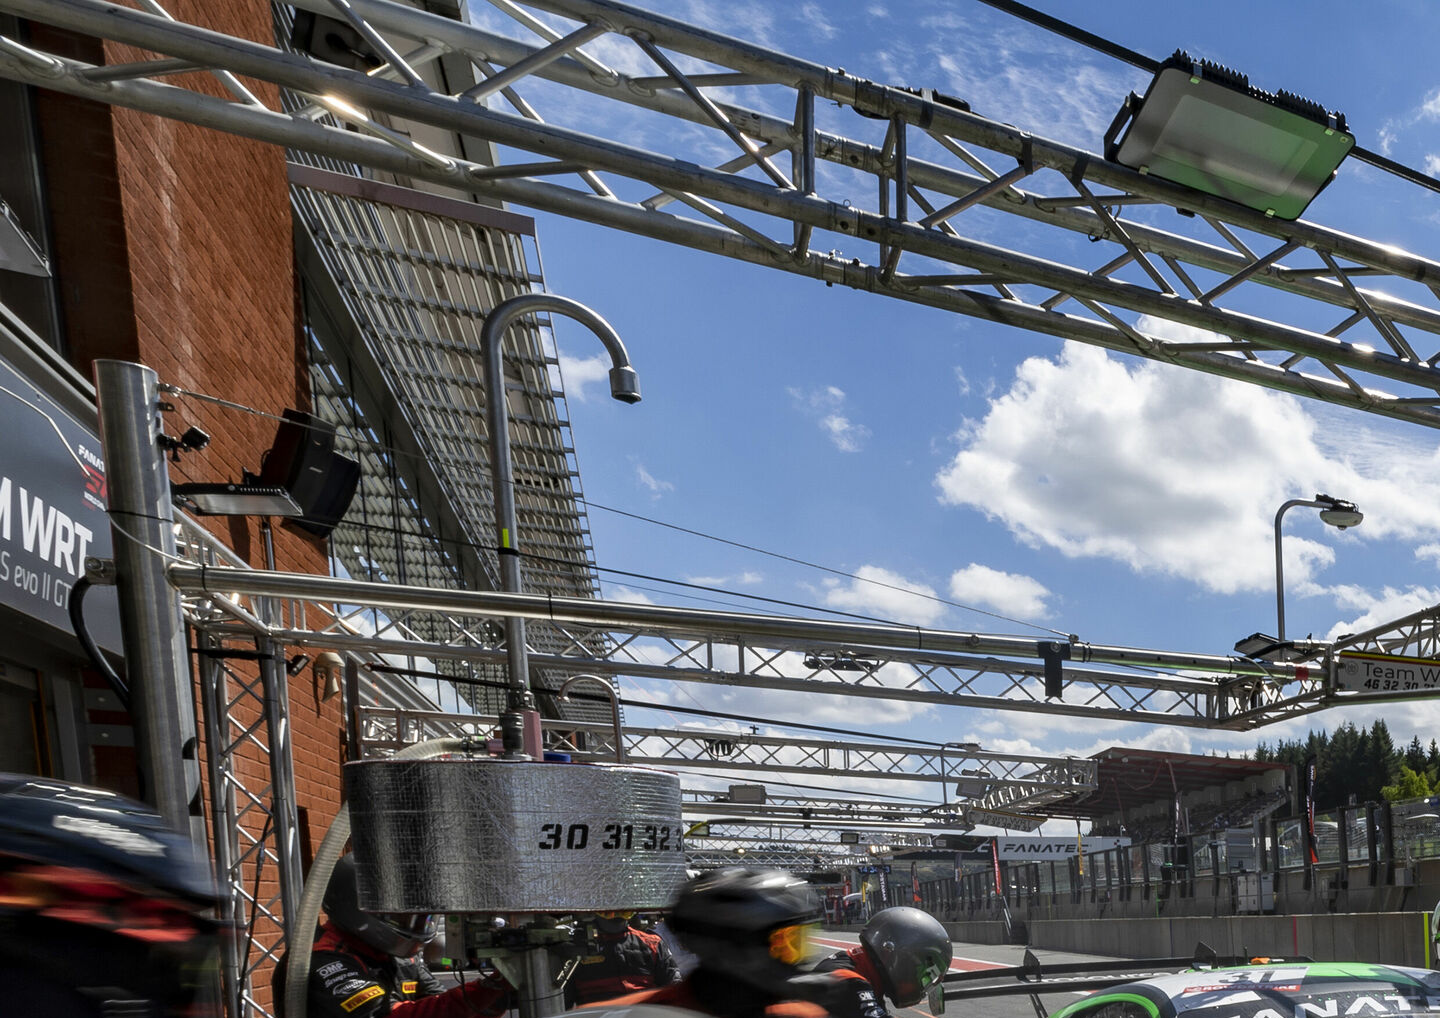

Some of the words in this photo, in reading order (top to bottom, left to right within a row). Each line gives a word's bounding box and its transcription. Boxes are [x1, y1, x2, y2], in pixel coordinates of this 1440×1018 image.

[19, 486, 94, 579] WRT
[14, 565, 39, 595] evo
[1362, 662, 1415, 681] Team
[1364, 678, 1380, 690] 46
[538, 823, 589, 850] 30
[602, 824, 634, 850] 31
[644, 825, 671, 851] 32
[1002, 843, 1090, 853] FANATEC
